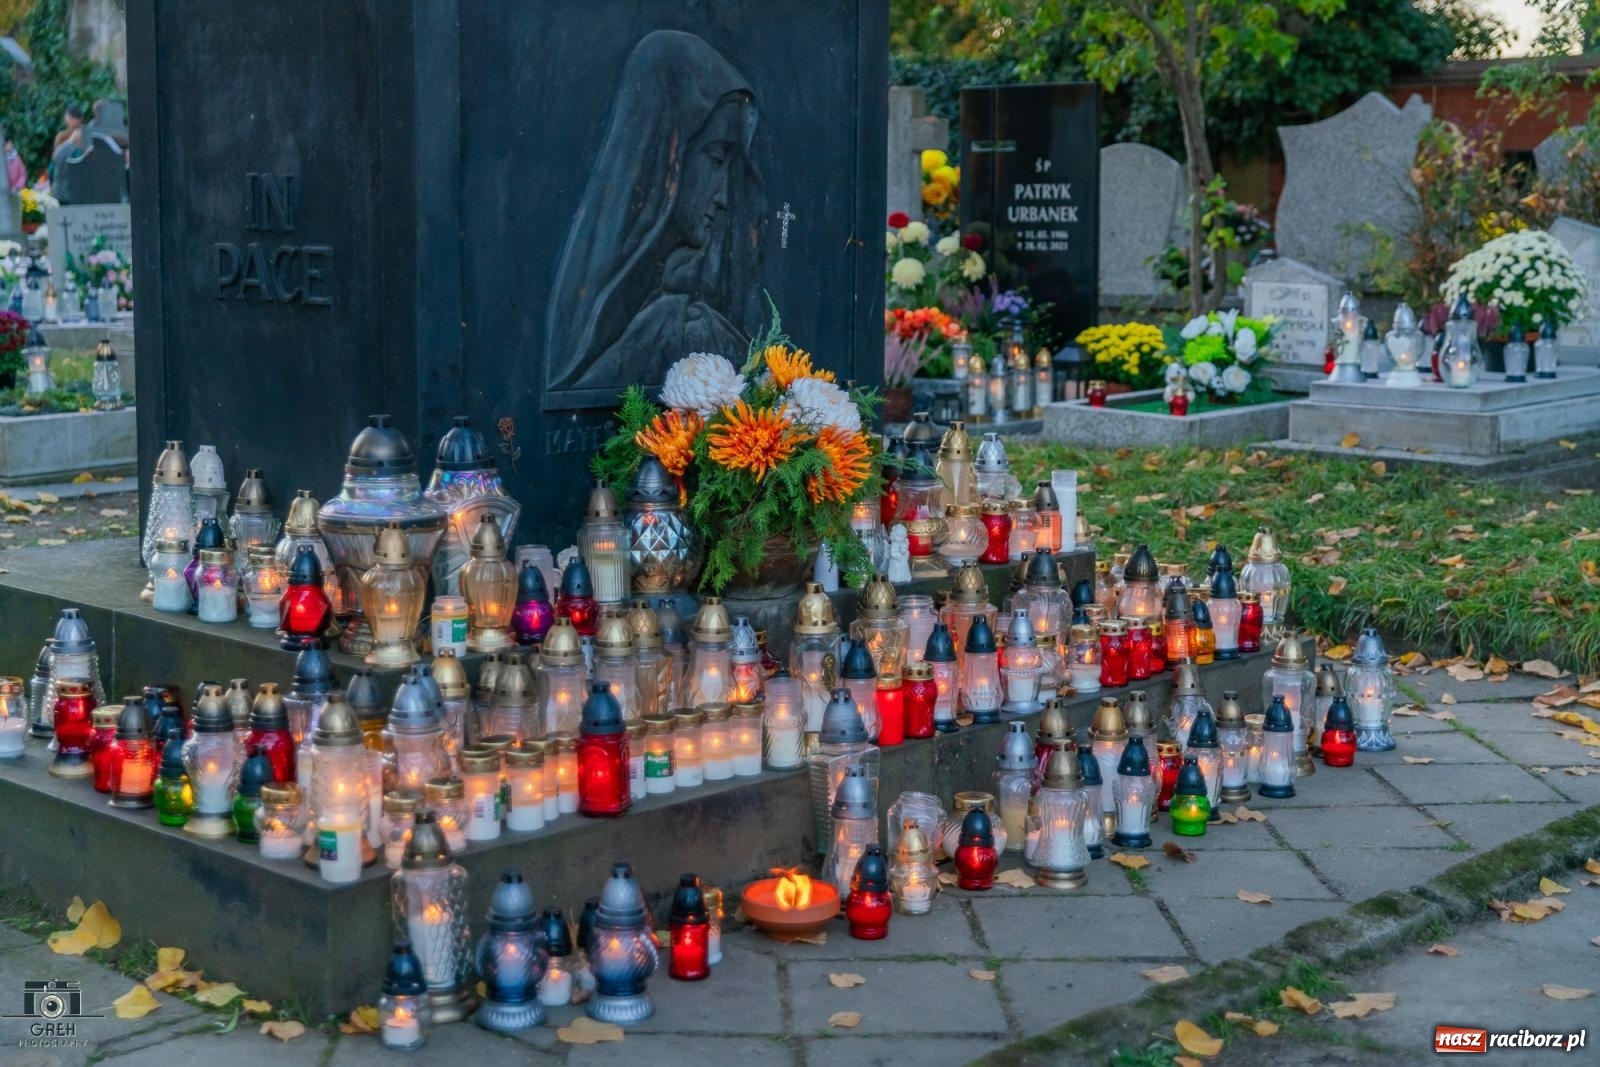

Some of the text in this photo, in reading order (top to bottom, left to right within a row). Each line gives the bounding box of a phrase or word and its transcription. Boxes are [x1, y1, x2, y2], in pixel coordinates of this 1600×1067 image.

[244, 172, 295, 232] IN
[1014, 183, 1072, 200] PATRYK
[1007, 206, 1079, 222] URBANEK
[213, 242, 334, 305] PACE
